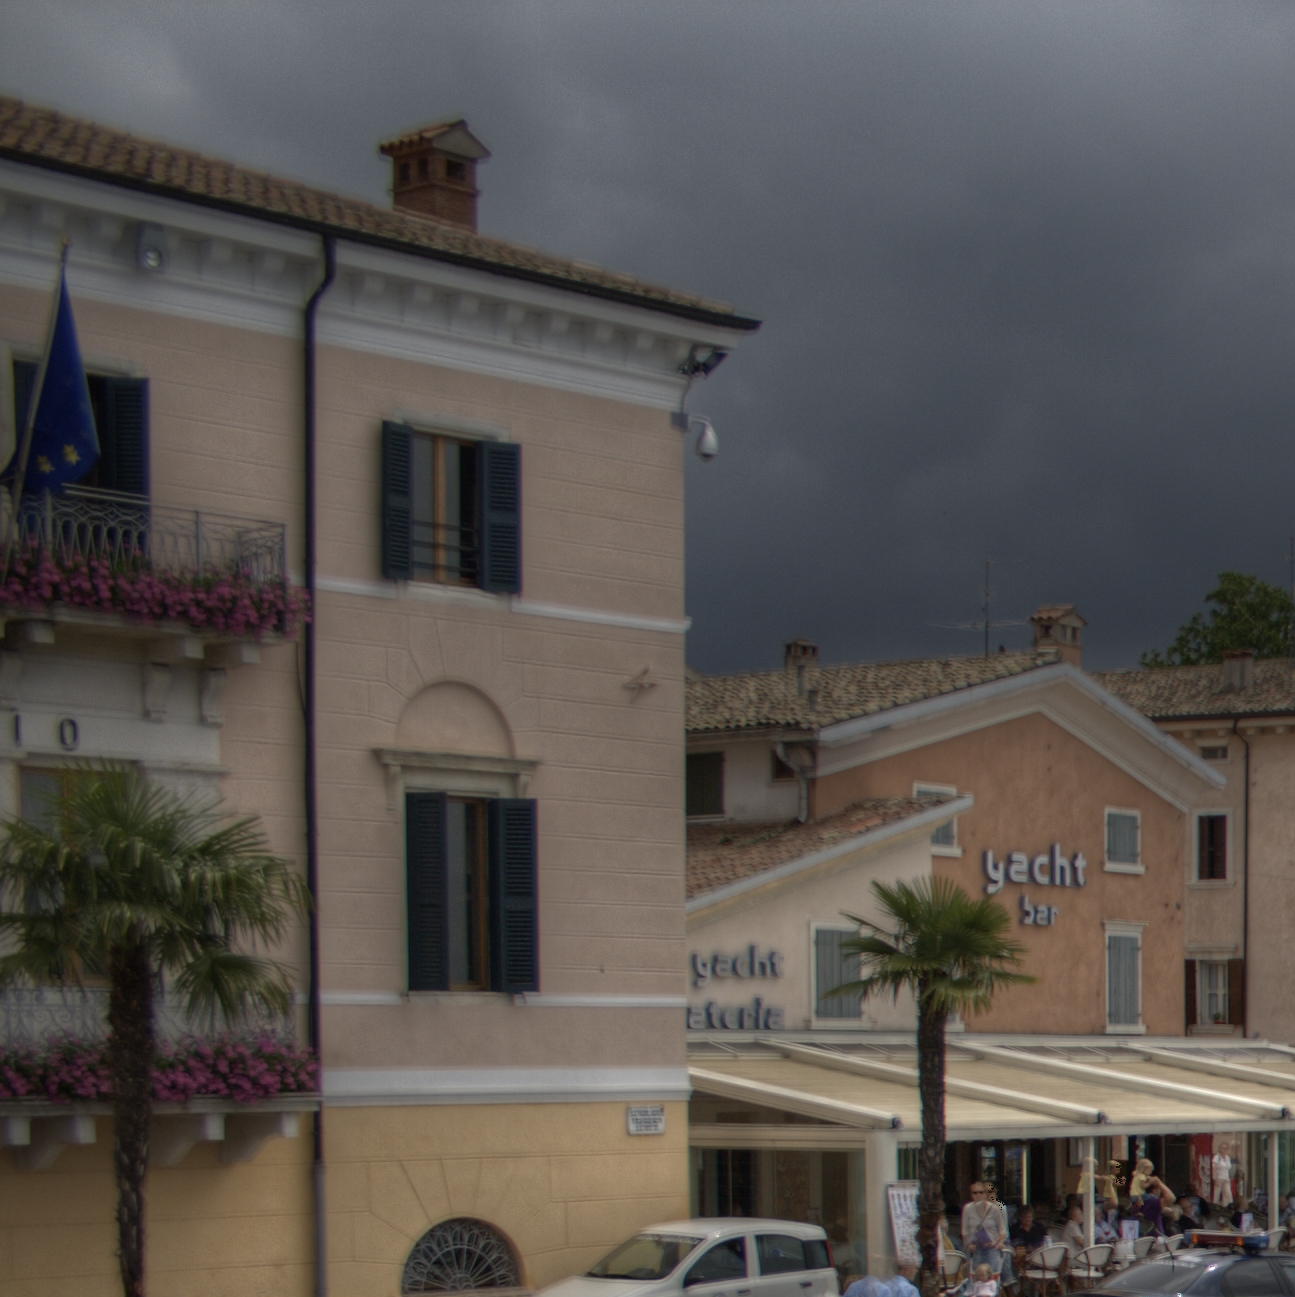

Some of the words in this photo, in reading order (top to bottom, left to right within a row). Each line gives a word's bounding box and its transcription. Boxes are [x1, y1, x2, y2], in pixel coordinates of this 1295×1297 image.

[982, 842, 1087, 895] yacht
[1018, 894, 1060, 926] bar
[691, 944, 784, 988] yacht
